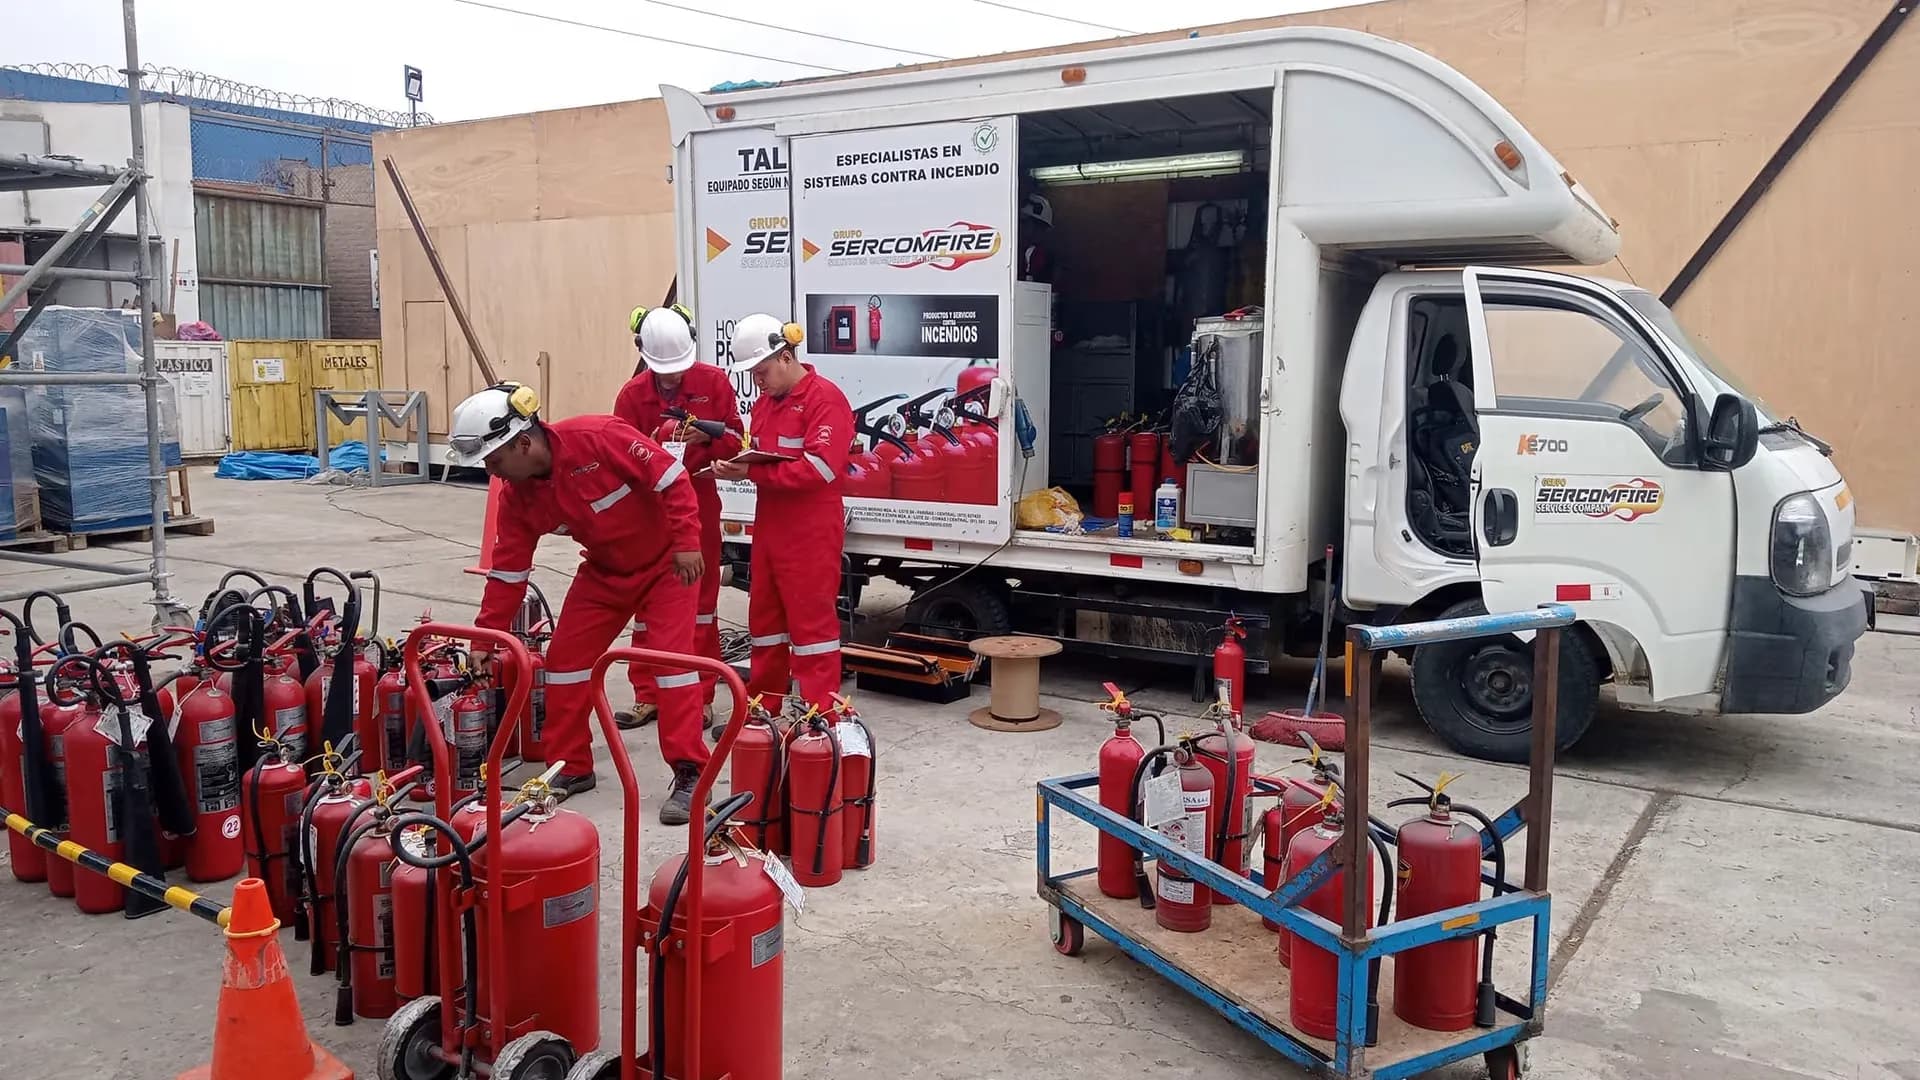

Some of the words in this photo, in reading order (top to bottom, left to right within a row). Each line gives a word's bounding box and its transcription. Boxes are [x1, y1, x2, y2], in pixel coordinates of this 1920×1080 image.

[738, 147, 787, 172] TAL
[836, 147, 938, 167] ESPECIALISTAS
[943, 144, 962, 158] EN
[707, 178, 750, 193] EQUIPADO
[752, 174, 782, 190] SEGÚN
[804, 173, 868, 190] SISTEMAS
[871, 168, 927, 185] CONTRA
[931, 162, 1000, 180] INCENDIO
[748, 216, 788, 230] GRUPO
[743, 230, 790, 255] SE
[833, 229, 863, 240] GRUPO
[828, 232, 994, 257] SERCOMFIRE
[921, 325, 978, 344] INCENDIOS
[323, 356, 368, 368] METALES
[1541, 477, 1567, 488] GRUPO
[1536, 487, 1660, 504] SERCOMFIRE
[1536, 502, 1573, 514] SERVICES
[1573, 502, 1611, 515] COMPANY
[226, 819, 240, 834] 22
